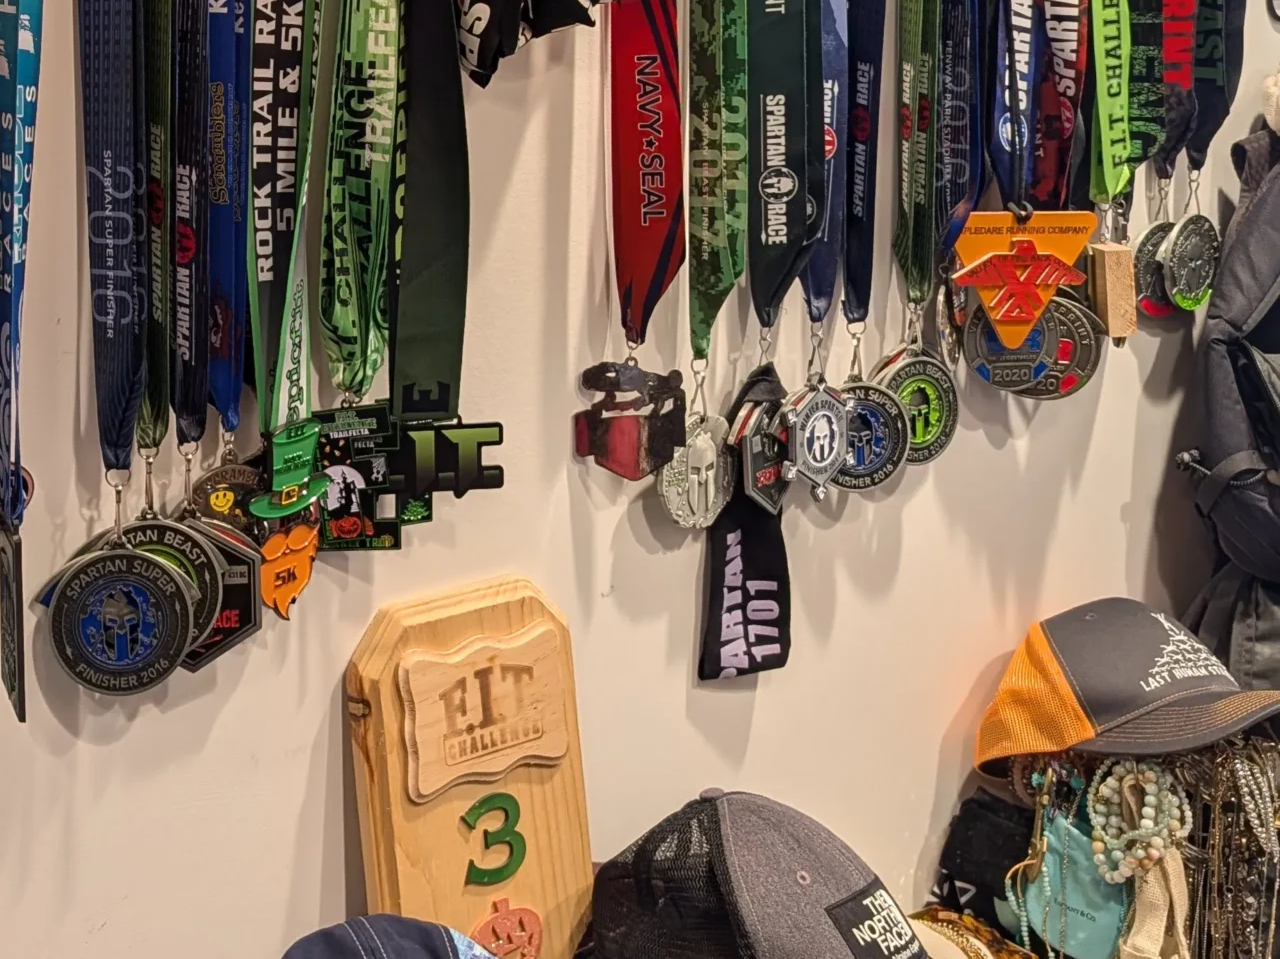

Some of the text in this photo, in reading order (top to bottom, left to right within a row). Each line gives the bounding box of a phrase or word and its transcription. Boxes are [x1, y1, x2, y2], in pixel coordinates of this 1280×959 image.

[252, 58, 275, 170] TRAIL
[276, 0, 305, 232] 5 MILE & 5K
[943, 92, 952, 123] PARK
[634, 53, 667, 227] NAVY SEAL
[852, 61, 871, 219] SPARTAN RACE
[901, 60, 913, 217] SPARTAN RACE
[701, 101, 710, 261] SPARTAN BEAST FINISHER
[765, 93, 788, 246] SPARTAN RACE
[914, 130, 927, 205] SPARTAN
[149, 121, 164, 325] SPARTAN RACE
[253, 182, 275, 282] ROCK
[1005, 225, 1092, 235] RUNNING COMPANY
[103, 149, 116, 340] SPARTAN SUPER FINISHER
[175, 163, 192, 362] SPARTAN RACE
[925, 363, 952, 391] BEAST
[993, 368, 1030, 382] 2020
[798, 404, 820, 433] WINTER
[867, 390, 899, 417] SUPER
[328, 428, 370, 440] TRAILFECTA
[929, 436, 948, 456] 2016
[801, 459, 829, 476] FINISHER
[873, 464, 895, 484] 2016
[163, 531, 208, 568] BEAST
[65, 559, 178, 601] SPARTAN SUPER
[273, 564, 299, 587] 5K
[745, 579, 782, 663] 1701
[74, 657, 171, 690] FINISHER 2016
[1140, 672, 1172, 693] LAST
[1172, 665, 1210, 680] HUMAN
[459, 791, 527, 888] 3
[862, 888, 893, 916] THE
[851, 904, 902, 947] NORTH
[876, 921, 914, 956] FACE
